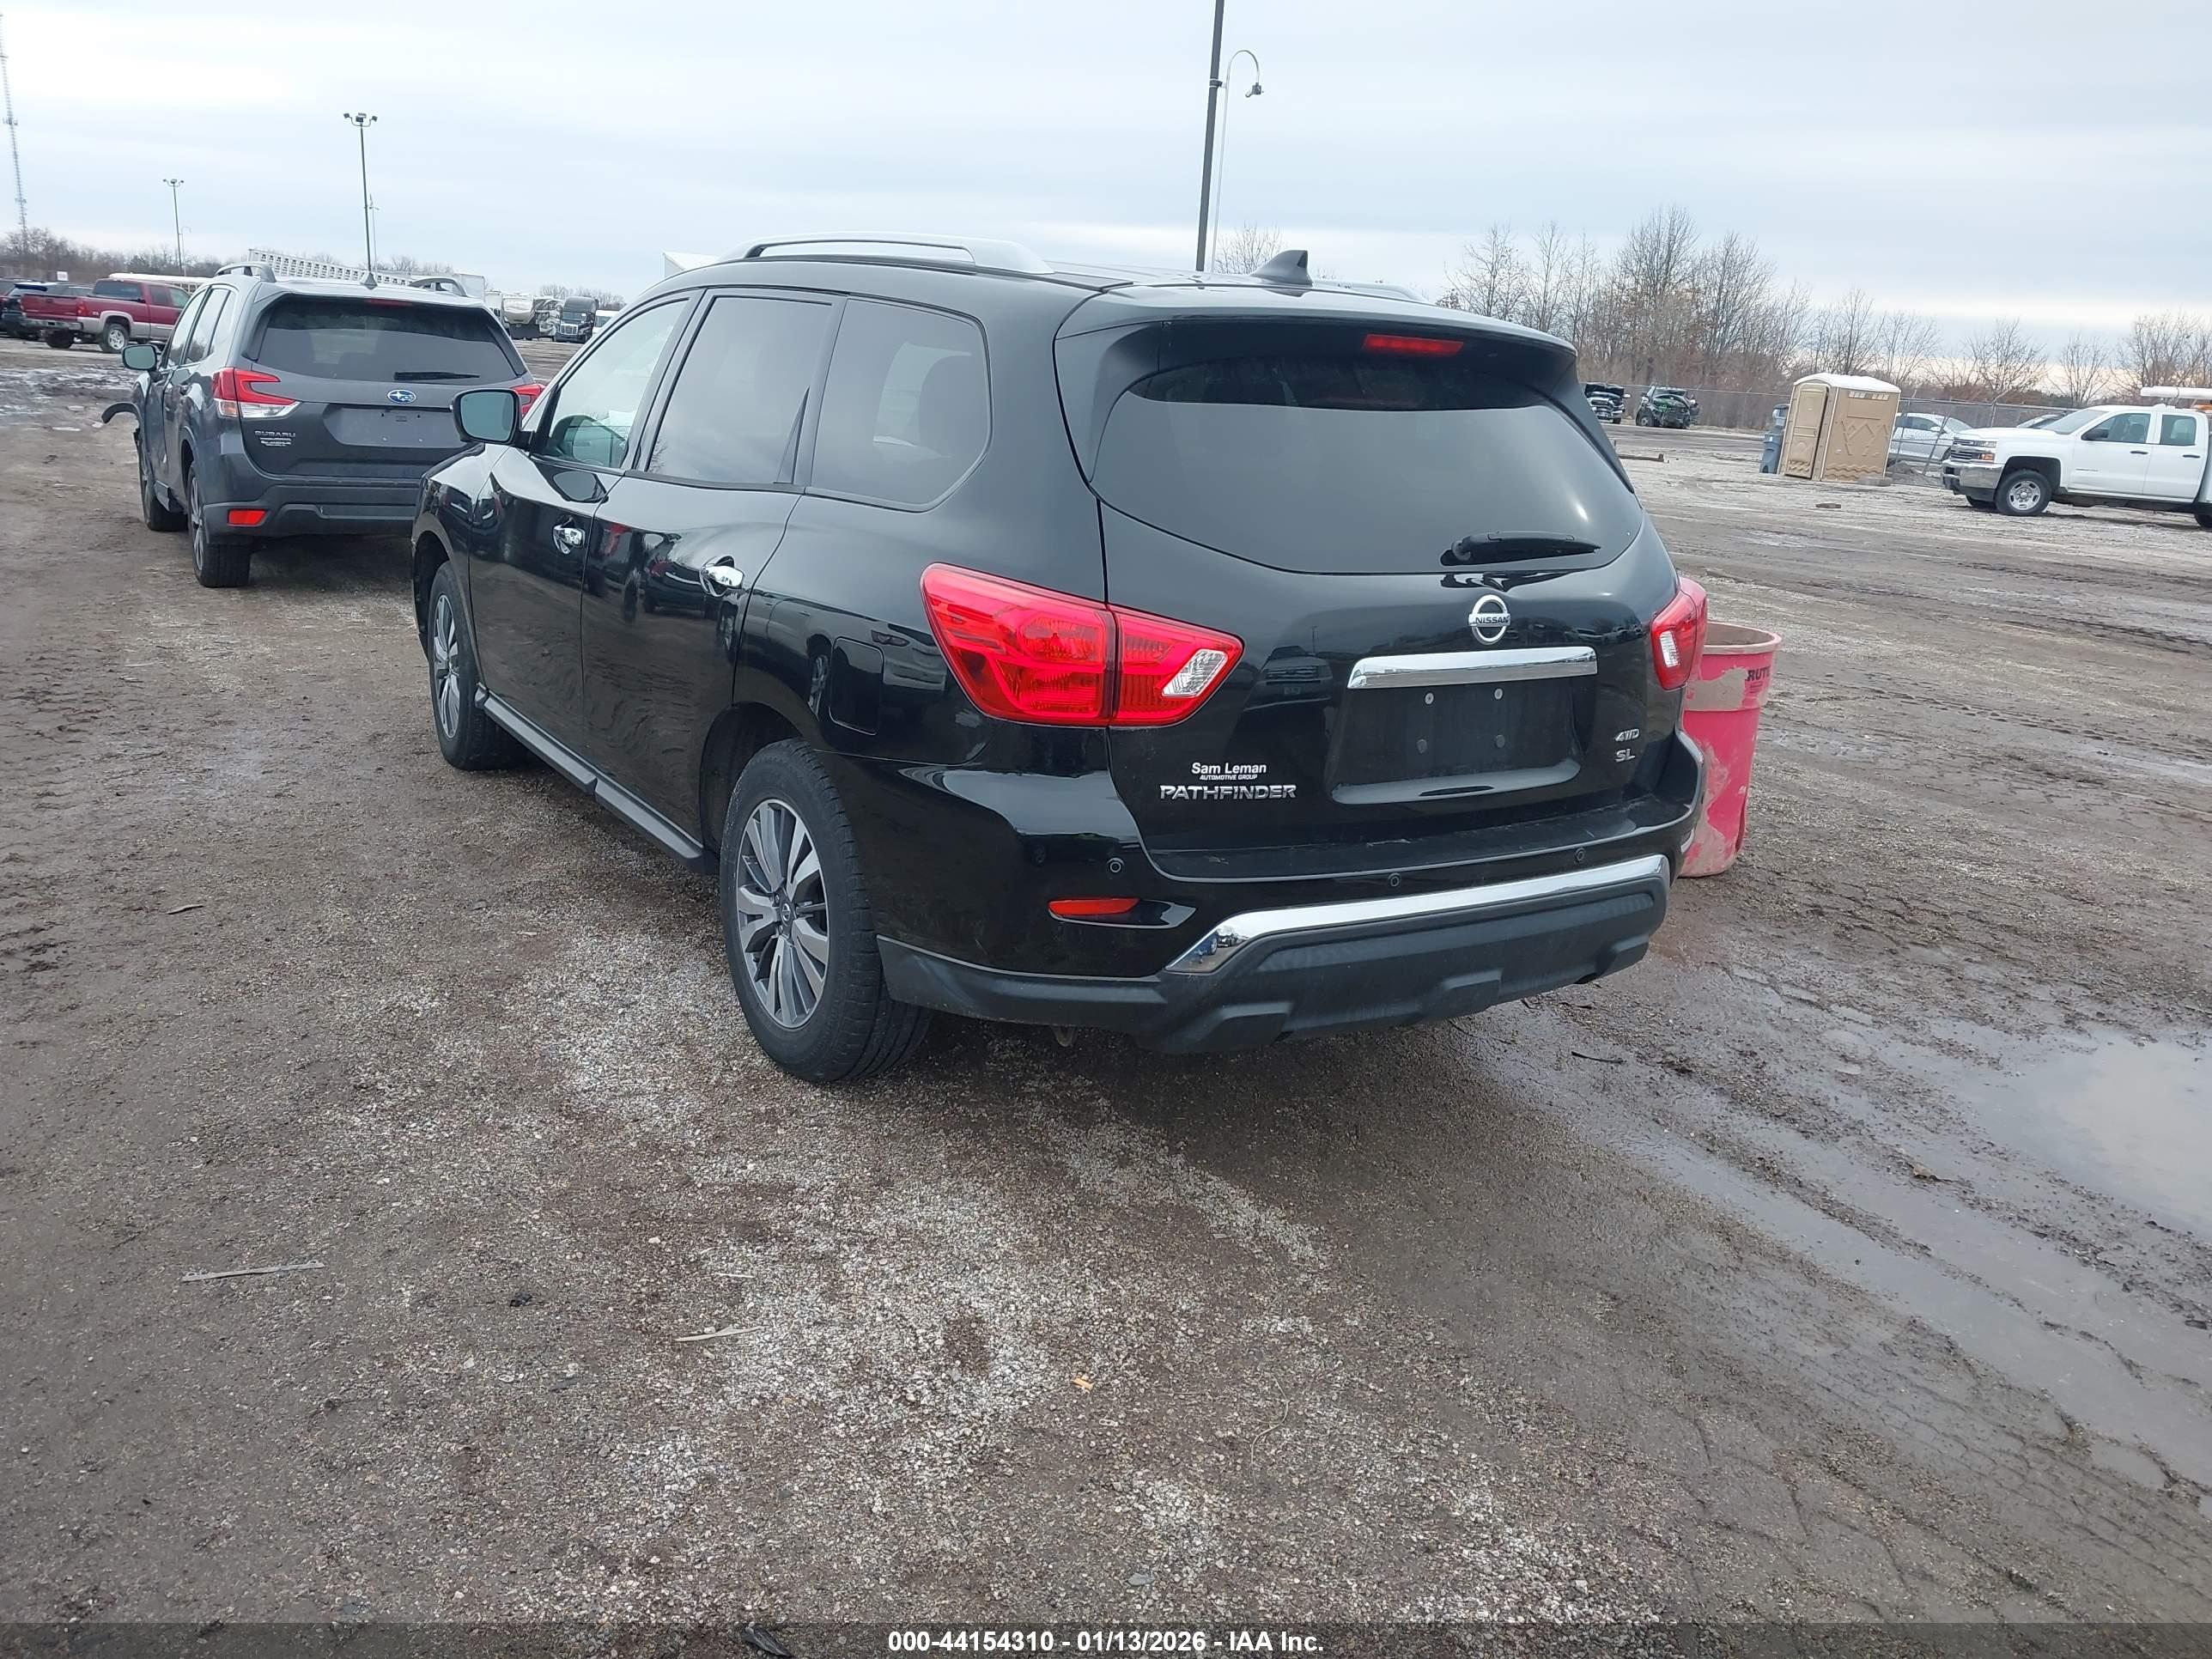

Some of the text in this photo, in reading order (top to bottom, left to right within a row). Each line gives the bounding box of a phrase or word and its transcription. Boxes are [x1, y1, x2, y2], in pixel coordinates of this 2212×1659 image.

[1614, 748, 1636, 763] SL
[1191, 762, 1267, 775] Sam Leman
[1159, 784, 1297, 800] PATHFINDER
